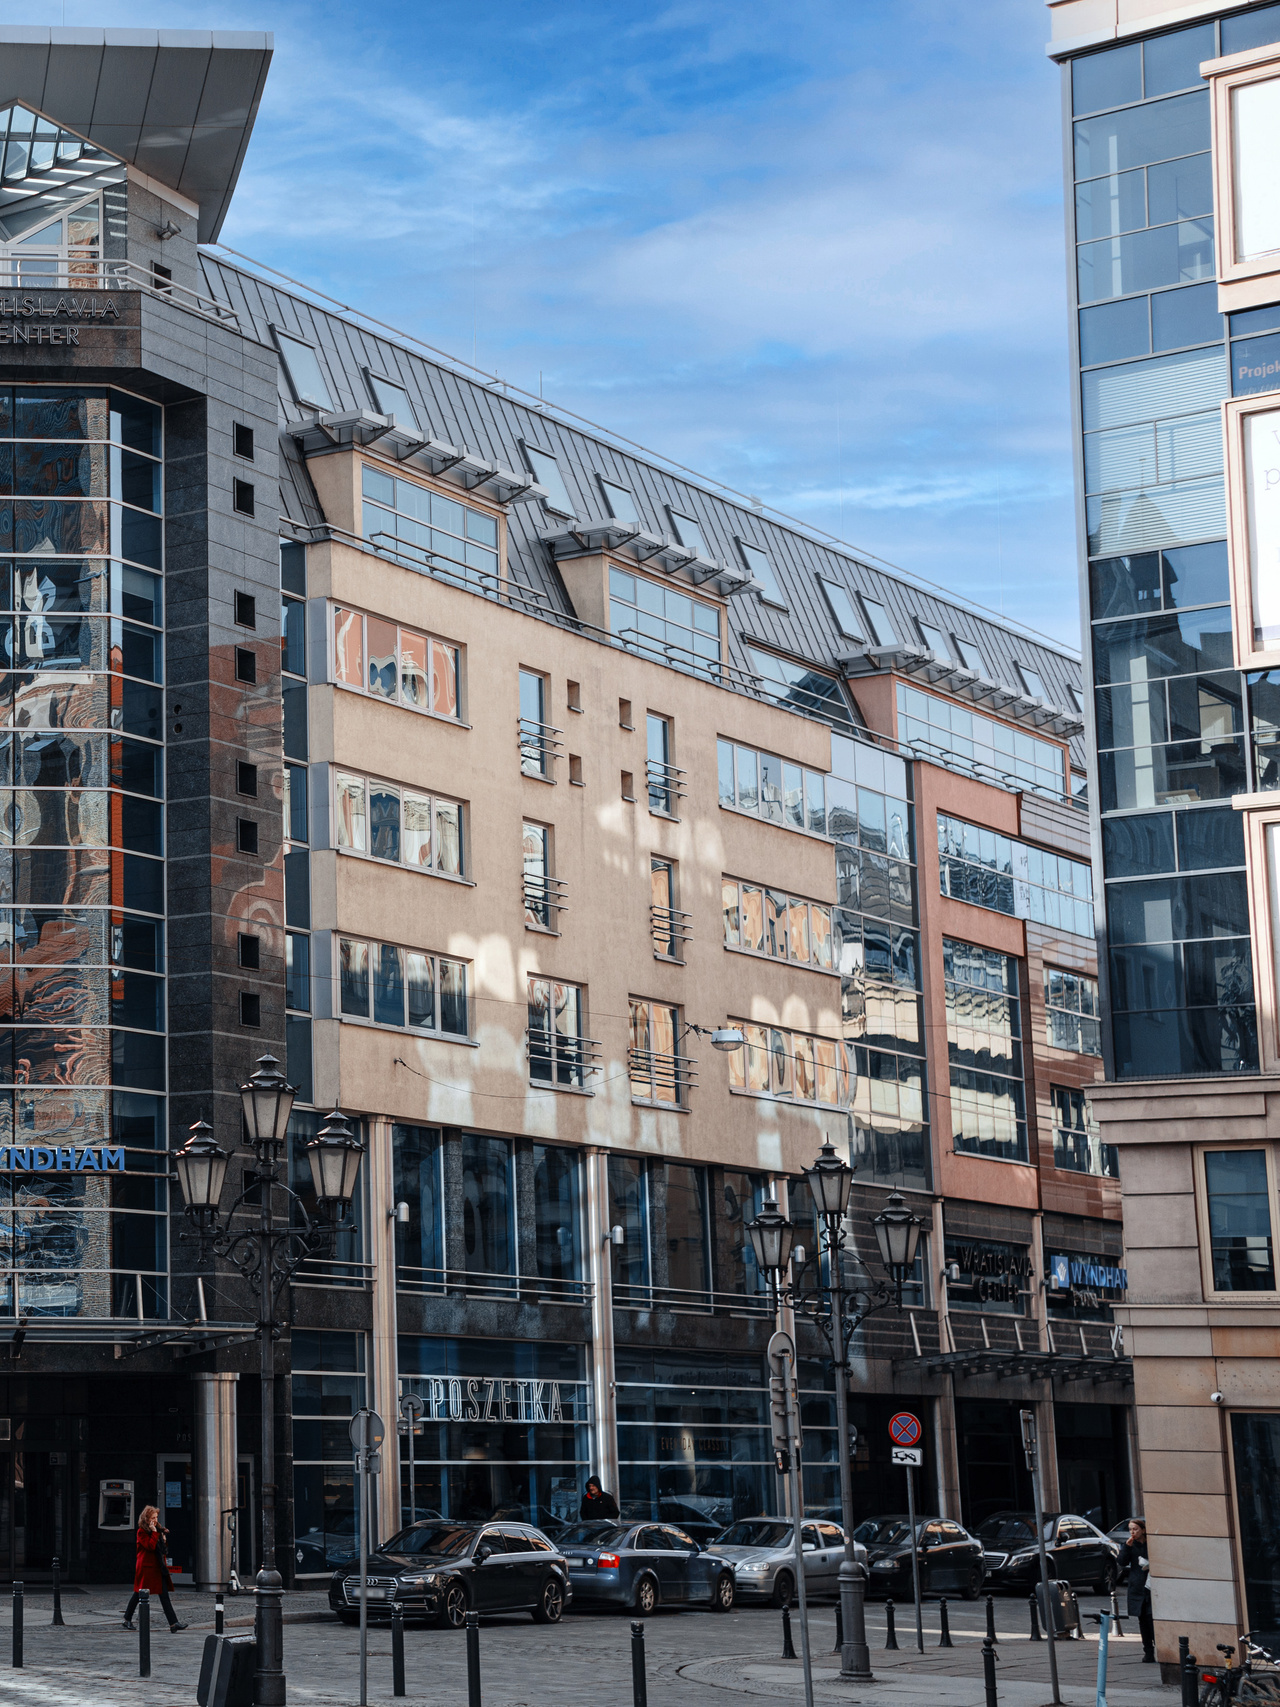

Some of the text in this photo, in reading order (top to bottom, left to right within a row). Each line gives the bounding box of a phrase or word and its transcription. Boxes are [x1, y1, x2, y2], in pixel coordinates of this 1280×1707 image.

[959, 1246, 1035, 1277] WRATISLAVIA
[976, 1276, 1020, 1303] CENTER
[430, 1377, 564, 1422] POSZETKA
[177, 1432, 193, 1442] POS
